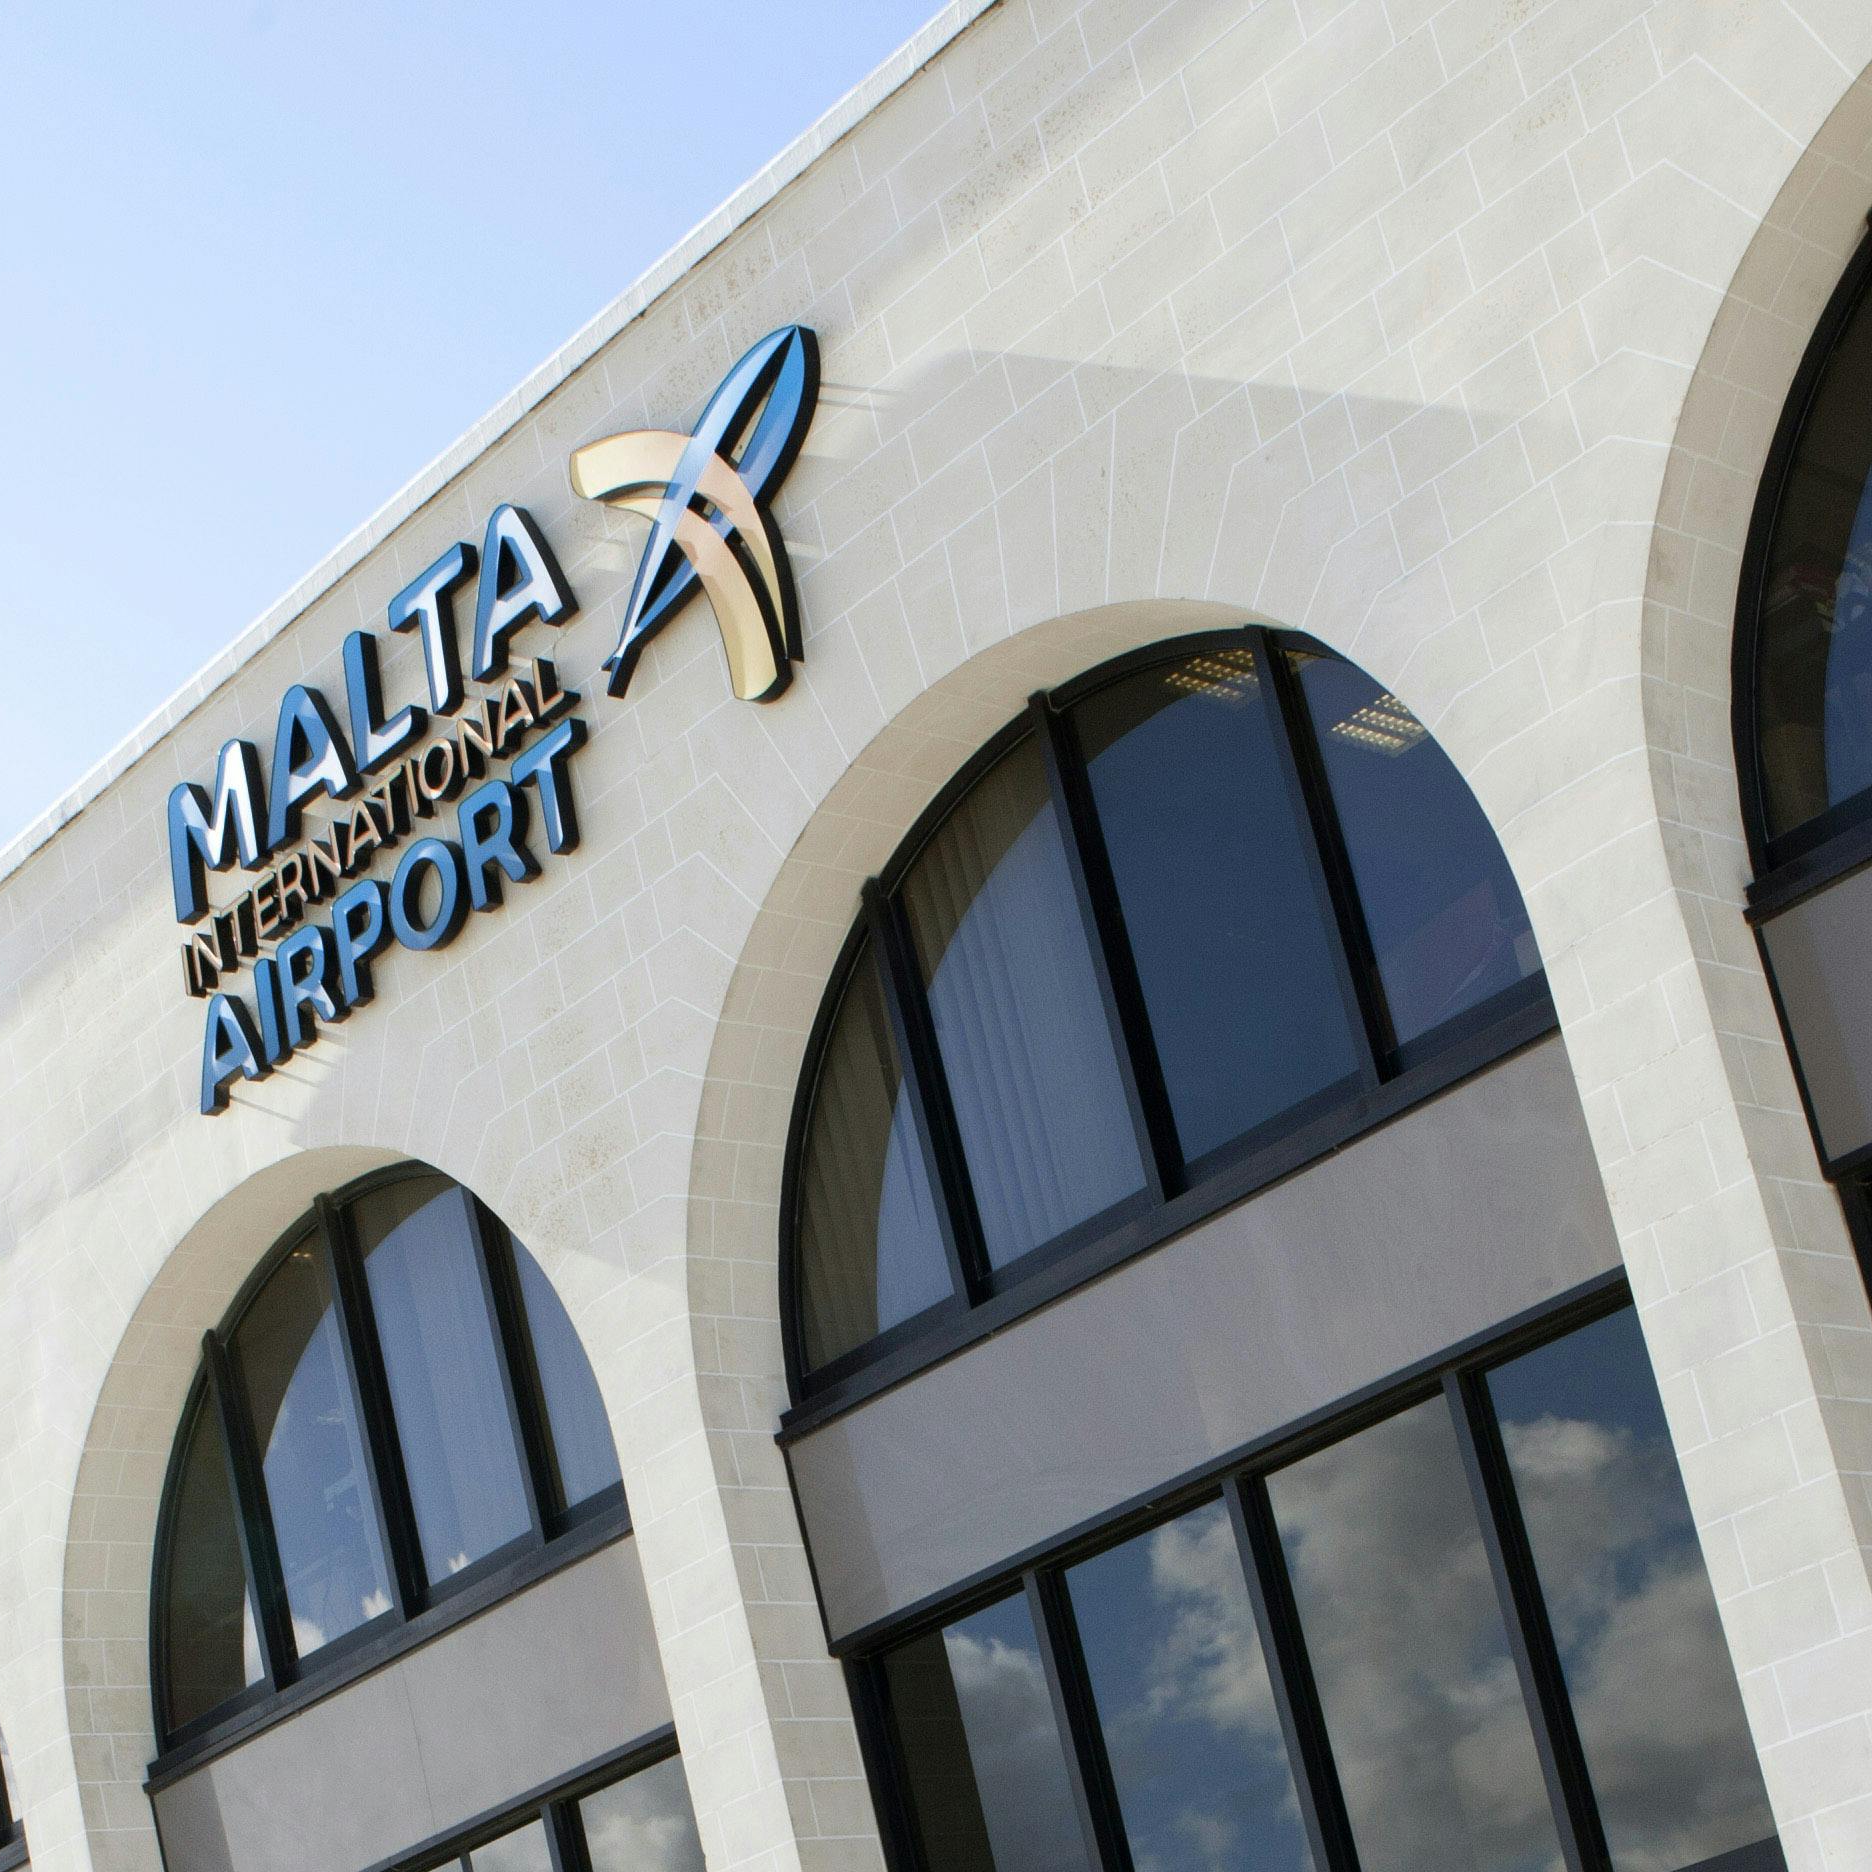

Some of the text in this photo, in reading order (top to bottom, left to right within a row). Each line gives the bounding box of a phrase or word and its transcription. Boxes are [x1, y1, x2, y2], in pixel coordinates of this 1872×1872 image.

[167, 503, 579, 925] MALTA
[181, 657, 581, 998] INTERNATIONAL
[199, 717, 588, 1117] AIRPORT
